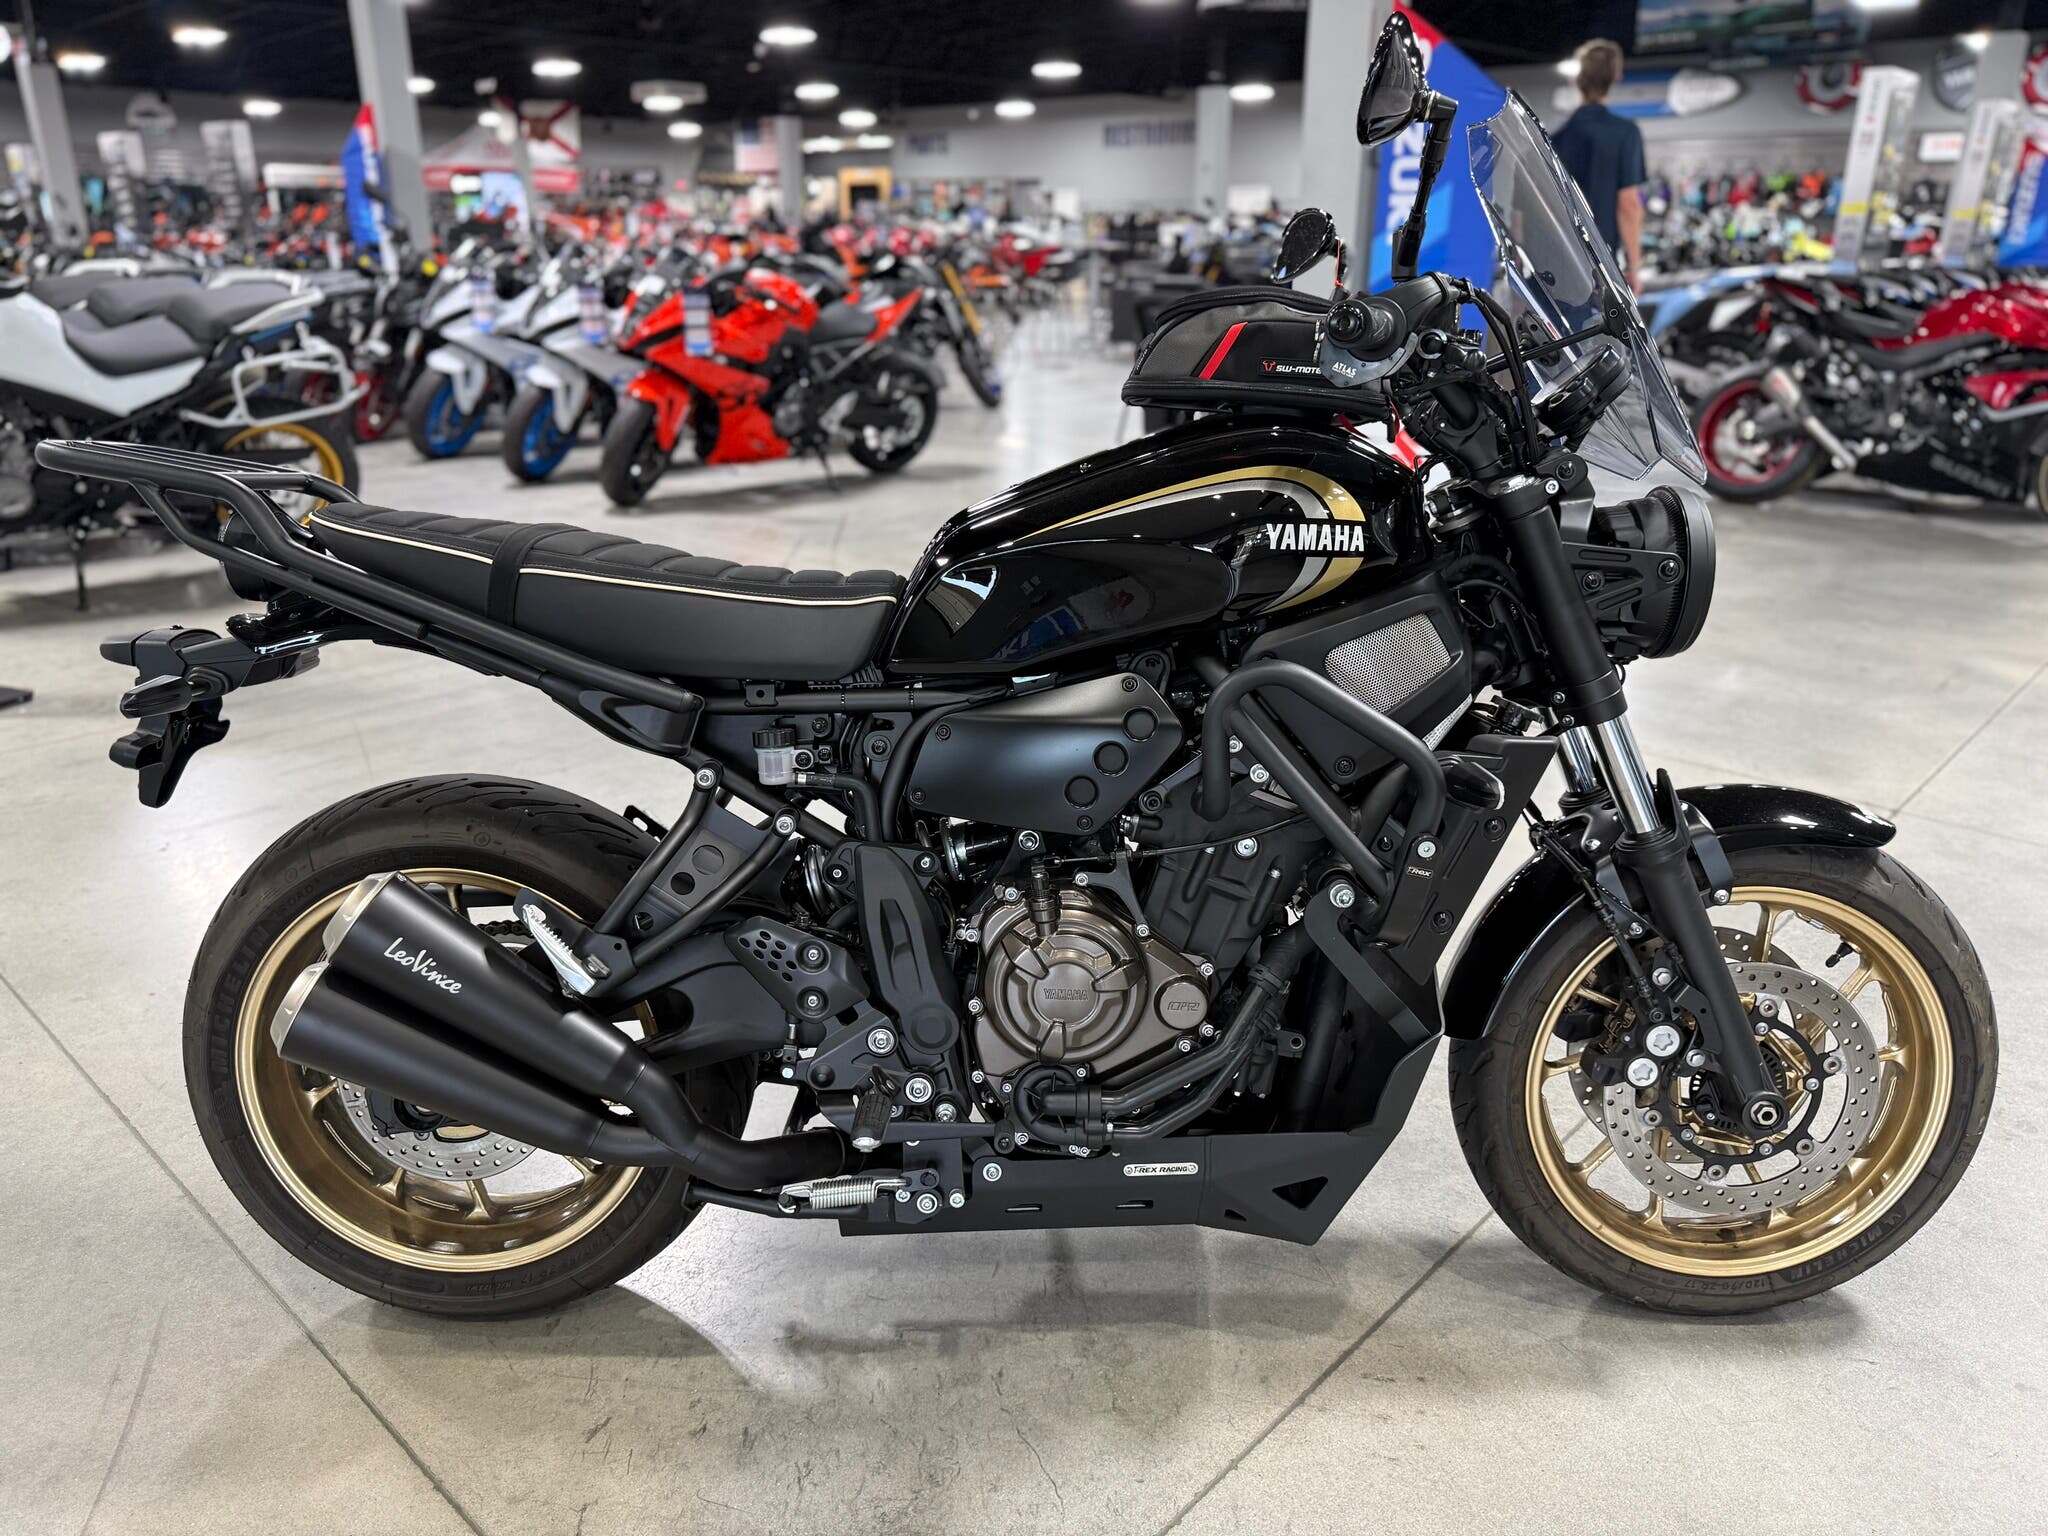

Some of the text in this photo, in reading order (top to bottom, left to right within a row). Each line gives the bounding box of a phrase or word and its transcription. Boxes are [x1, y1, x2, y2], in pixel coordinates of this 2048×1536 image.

[1333, 361, 1357, 376] ATLAS
[1266, 523, 1365, 552] YAMAHA
[384, 937, 462, 994] LeoVince
[1043, 988, 1089, 1000] YAMAHA
[1134, 1166, 1157, 1174] T-REX
